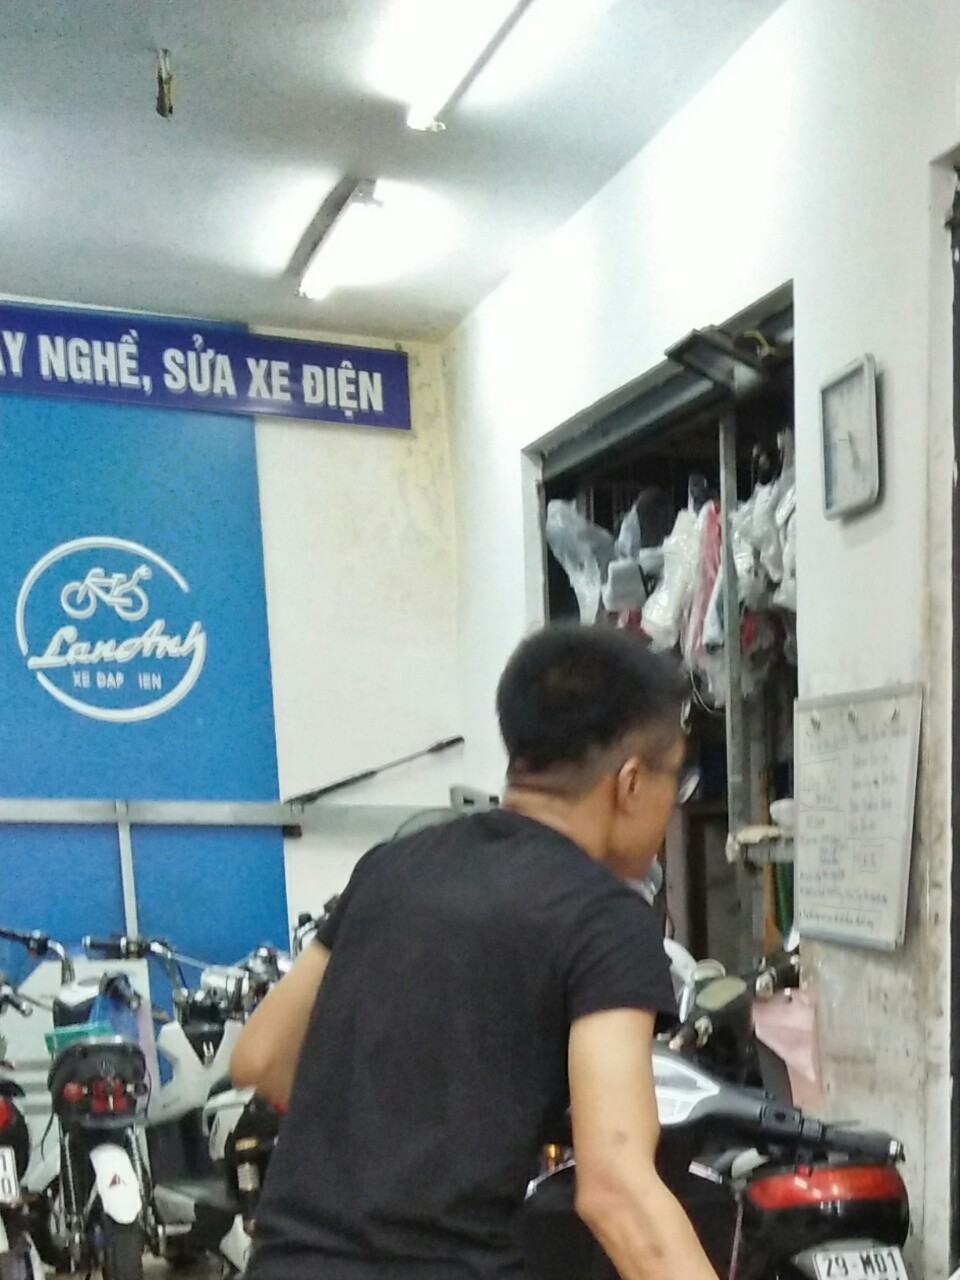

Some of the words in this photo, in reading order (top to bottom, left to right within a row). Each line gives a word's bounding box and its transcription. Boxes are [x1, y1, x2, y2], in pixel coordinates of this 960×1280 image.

[0, 330, 26, 377] Y
[38, 329, 153, 396] NGHỀ,
[162, 333, 237, 396] SỬA
[246, 357, 291, 402] XE
[302, 360, 384, 420] ĐIỆN
[73, 670, 91, 688] XE
